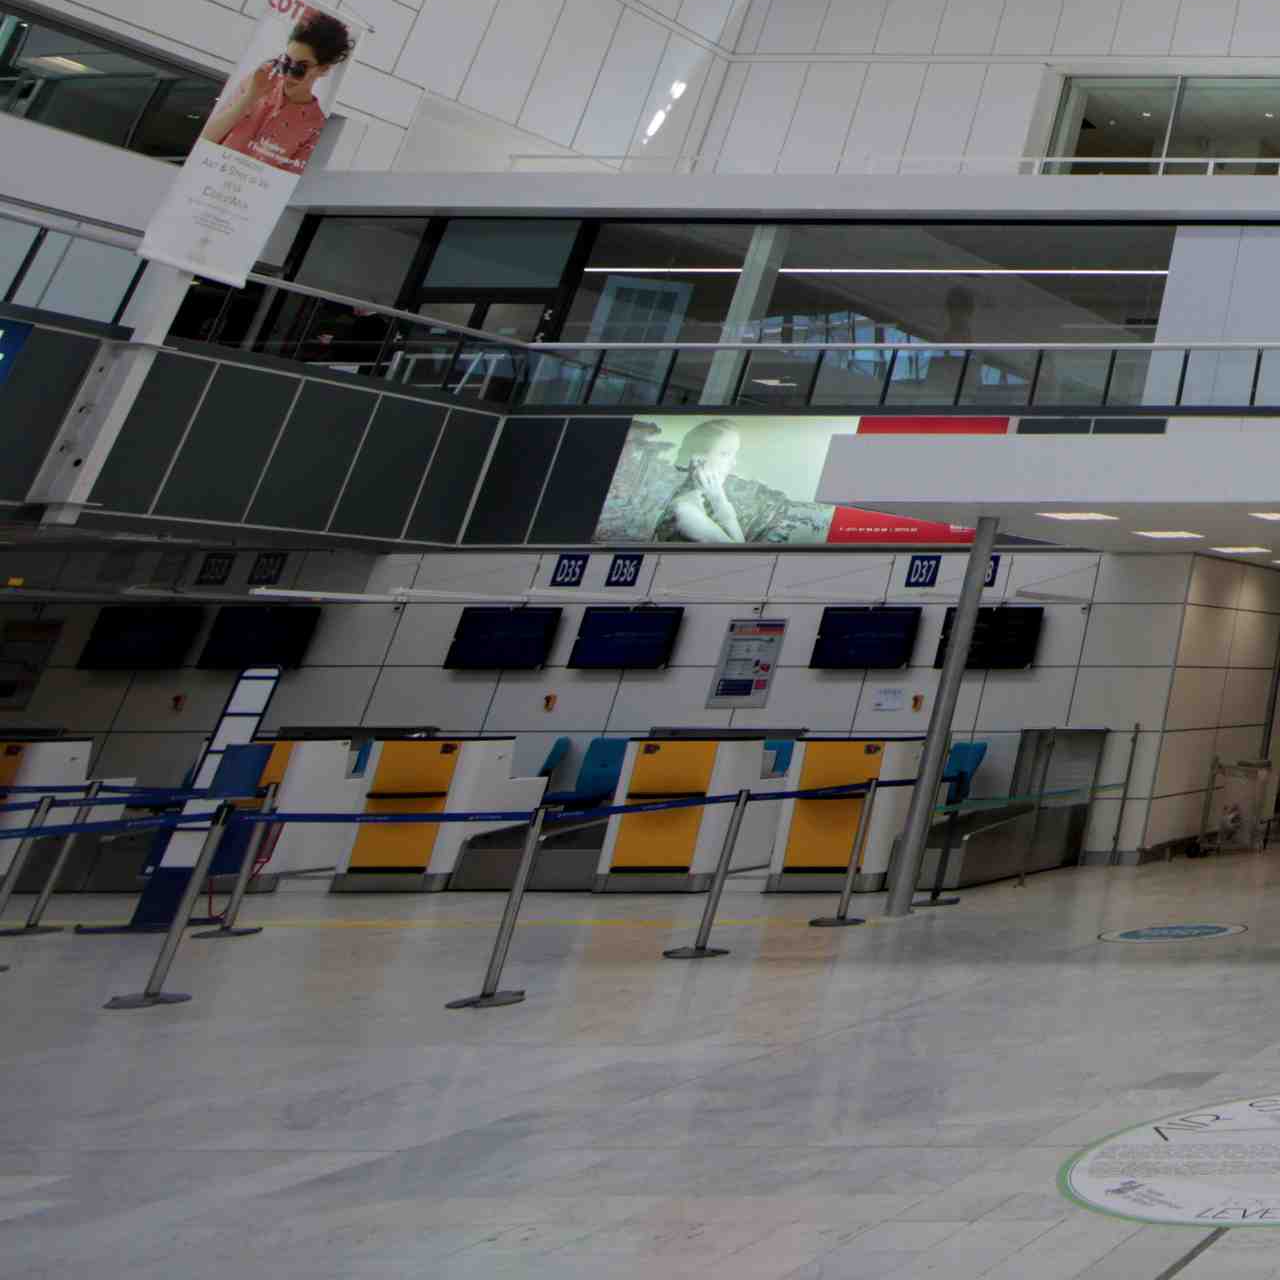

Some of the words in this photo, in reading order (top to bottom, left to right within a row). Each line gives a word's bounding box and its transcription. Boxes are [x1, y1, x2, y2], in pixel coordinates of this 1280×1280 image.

[556, 558, 583, 583] D35
[611, 558, 638, 583] D36
[910, 558, 937, 583] D37
